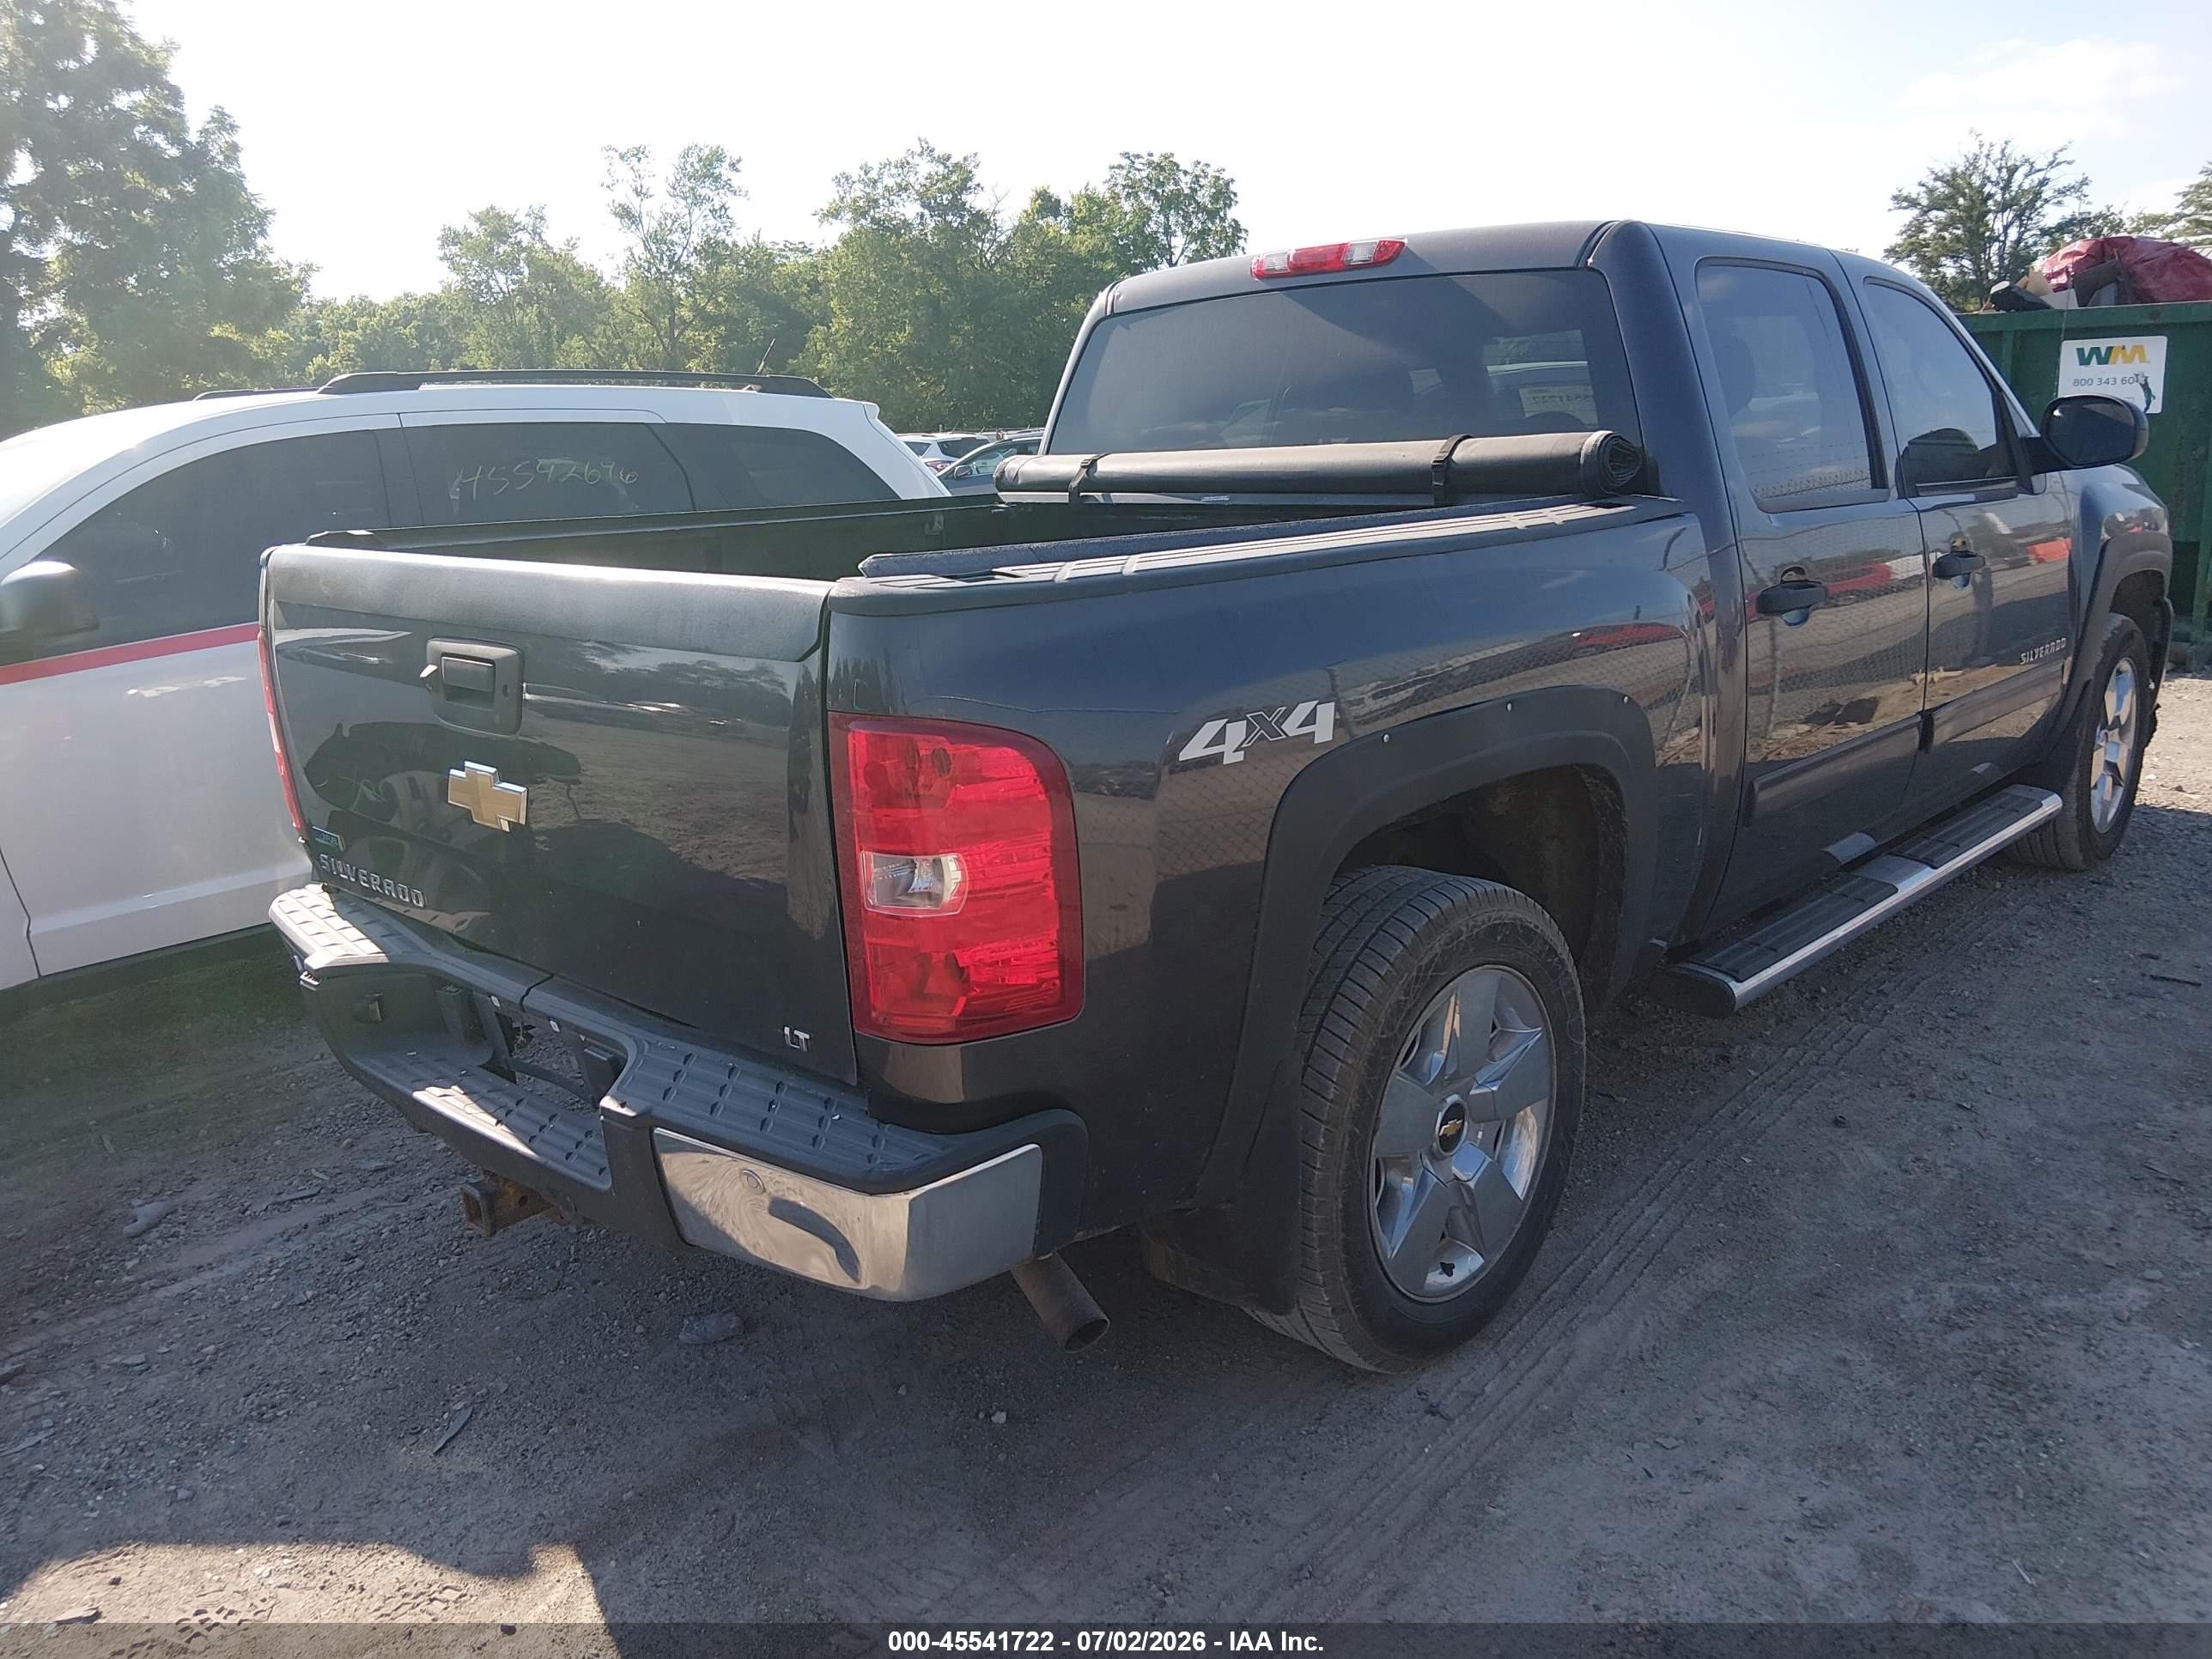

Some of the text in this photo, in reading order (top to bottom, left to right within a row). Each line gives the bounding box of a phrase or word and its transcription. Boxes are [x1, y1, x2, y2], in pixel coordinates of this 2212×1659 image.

[2076, 344, 2147, 365] WM
[2074, 378, 2094, 386] 800
[2021, 638, 2066, 665] SILVERADO
[319, 854, 426, 907] SILVERADO
[783, 1026, 811, 1052] LT
